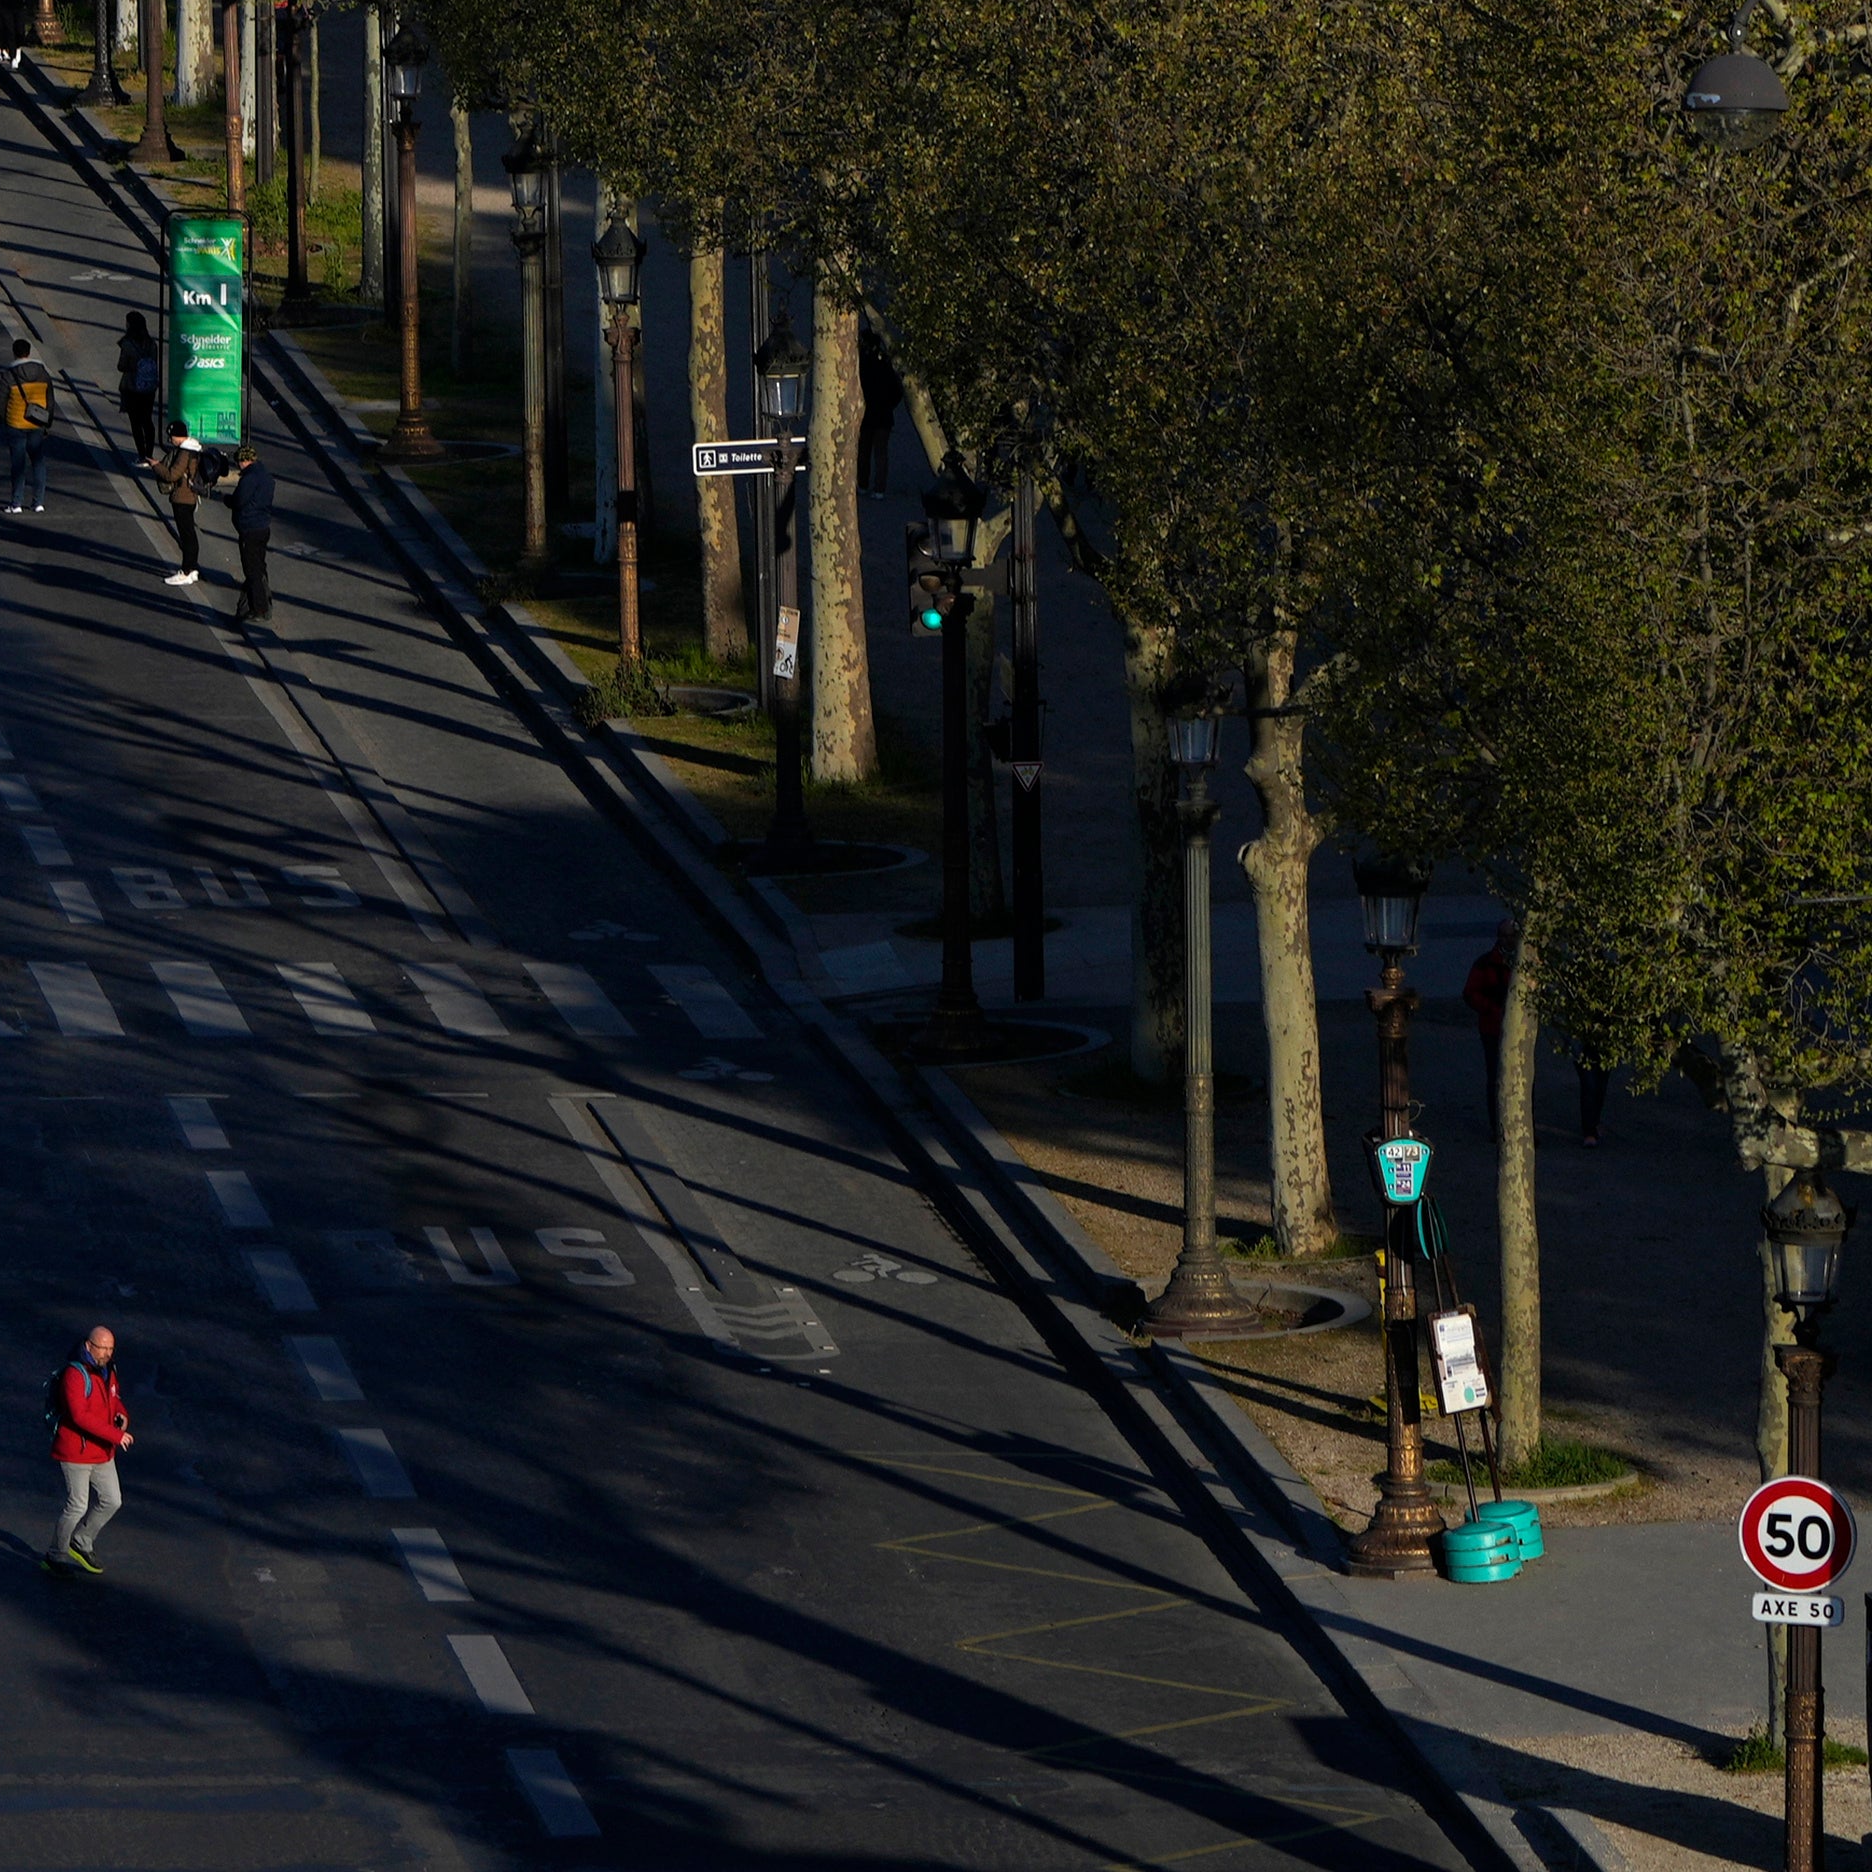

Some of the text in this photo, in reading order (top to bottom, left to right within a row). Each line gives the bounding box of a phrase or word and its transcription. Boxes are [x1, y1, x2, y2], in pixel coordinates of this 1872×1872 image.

[183, 290, 211, 305] Km
[180, 333, 231, 347] Schneider
[197, 358, 224, 368] asics
[109, 865, 362, 909] BUS
[1389, 1148, 1418, 1156] 42 73
[1766, 1513, 1831, 1560] 50
[1761, 1600, 1834, 1619] AXE 50
